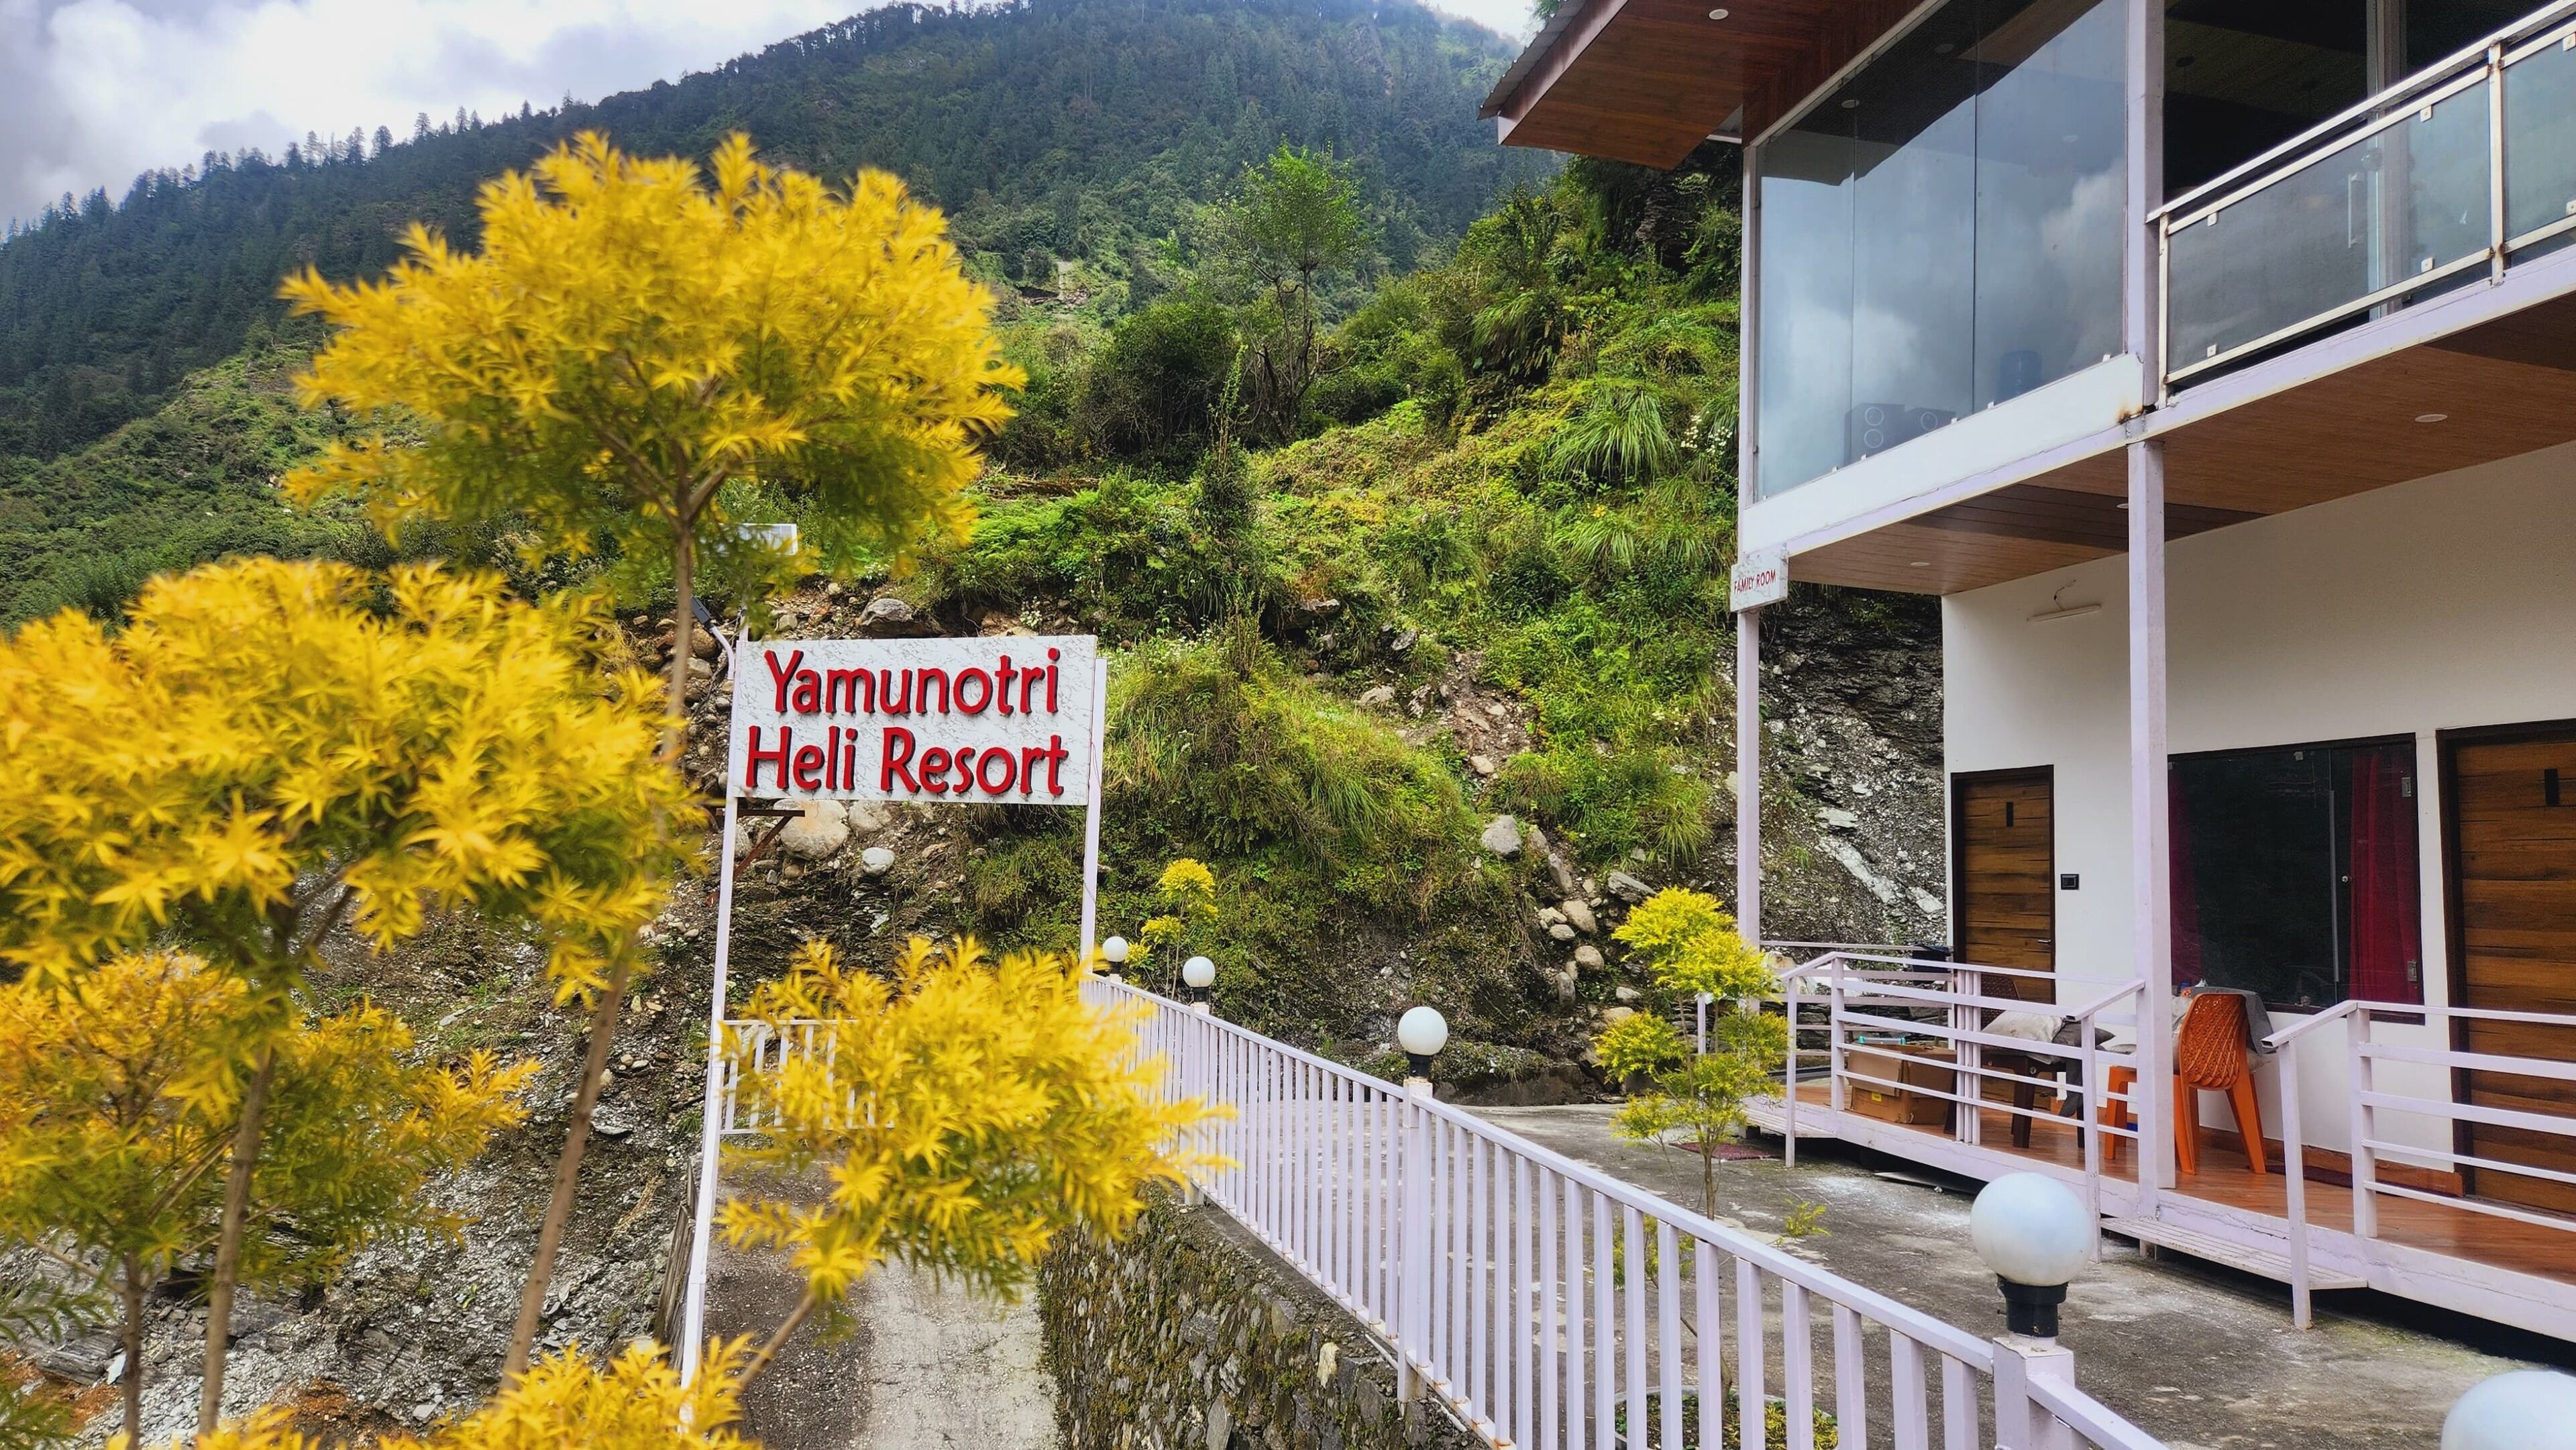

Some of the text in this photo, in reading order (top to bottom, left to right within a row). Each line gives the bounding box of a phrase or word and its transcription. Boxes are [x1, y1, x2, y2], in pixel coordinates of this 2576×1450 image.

[1734, 569, 1776, 594] FAMILY ROOM
[763, 647, 1061, 715] Yamunotri
[745, 725, 1069, 796] Heli Resort
